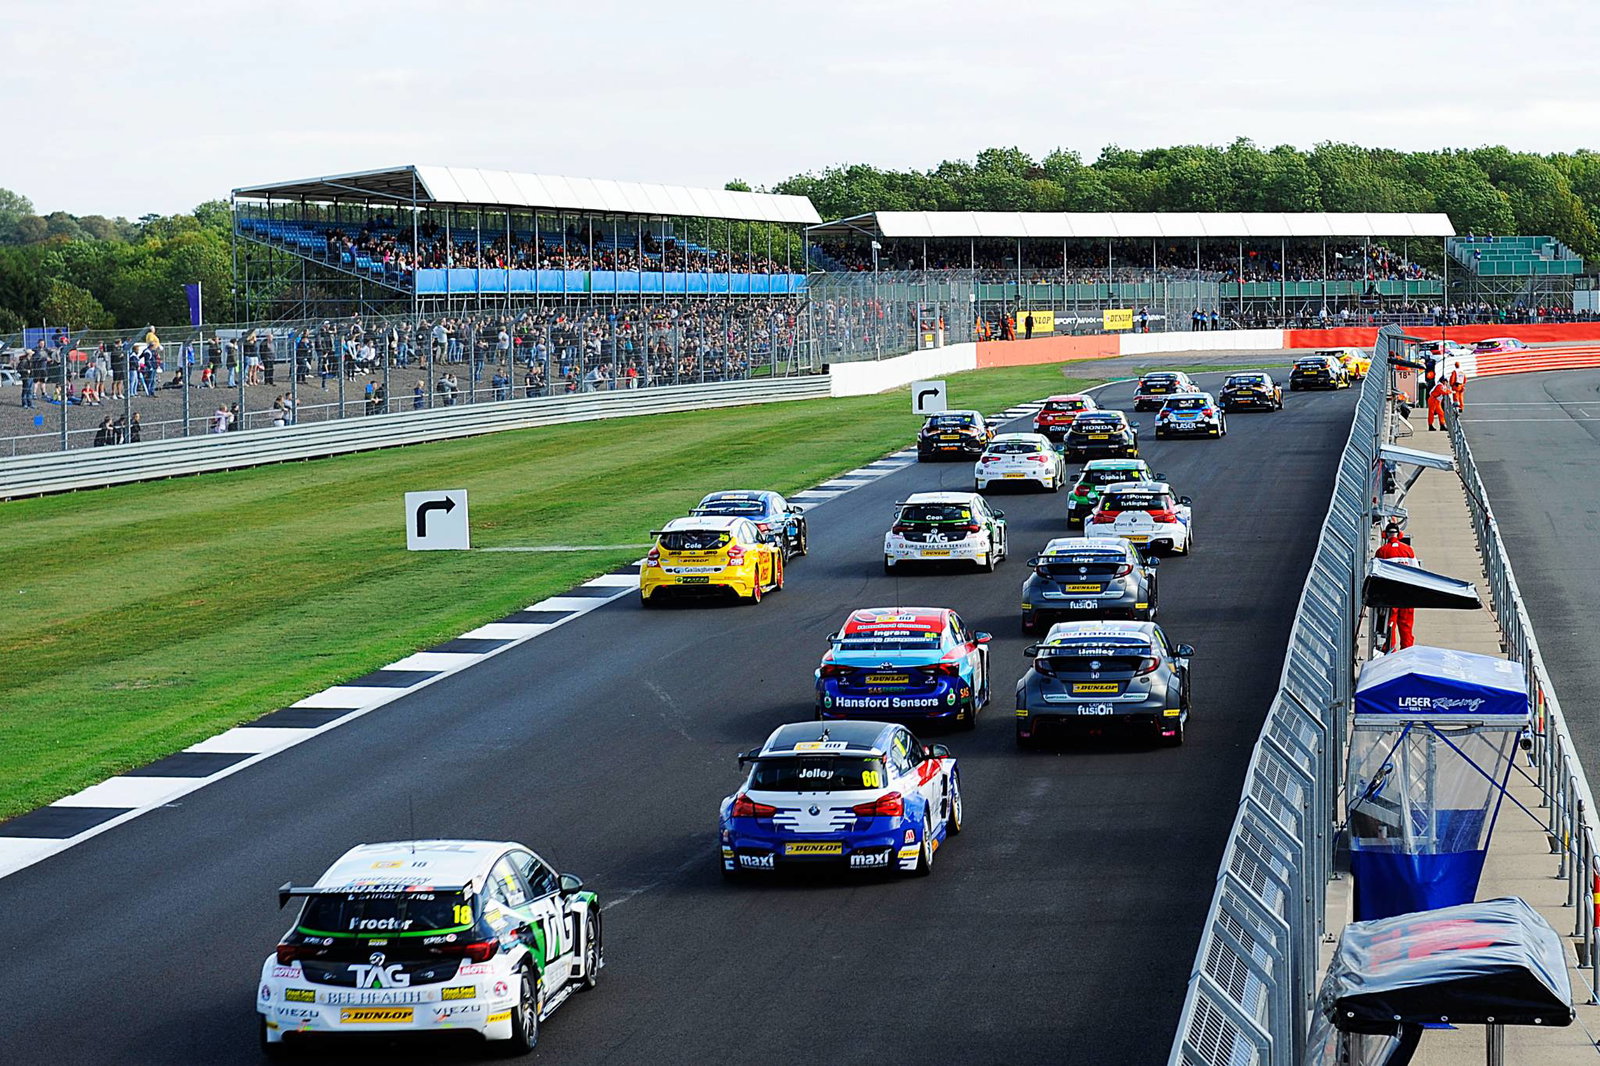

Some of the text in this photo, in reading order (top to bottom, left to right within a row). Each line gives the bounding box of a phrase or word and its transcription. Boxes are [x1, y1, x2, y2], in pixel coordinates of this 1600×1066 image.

[1110, 314, 1131, 323] DUNLOP
[1104, 502, 1111, 511] 2
[922, 533, 949, 543] TAG
[959, 687, 970, 698] SAS
[835, 696, 939, 708] Hansford Sensors
[1398, 697, 1431, 707] LASER
[798, 768, 834, 779] Jelley
[739, 853, 775, 867] maxi
[850, 848, 892, 866] maxi
[452, 904, 472, 925] 18
[349, 917, 413, 930] Proctor
[347, 964, 410, 988] TAG
[327, 991, 355, 1004] BEE
[360, 991, 421, 1005] HEALTH
[277, 1007, 319, 1018] VIEZU
[432, 1004, 481, 1015] VIEZU
[352, 1011, 413, 1020] DUNLOP
